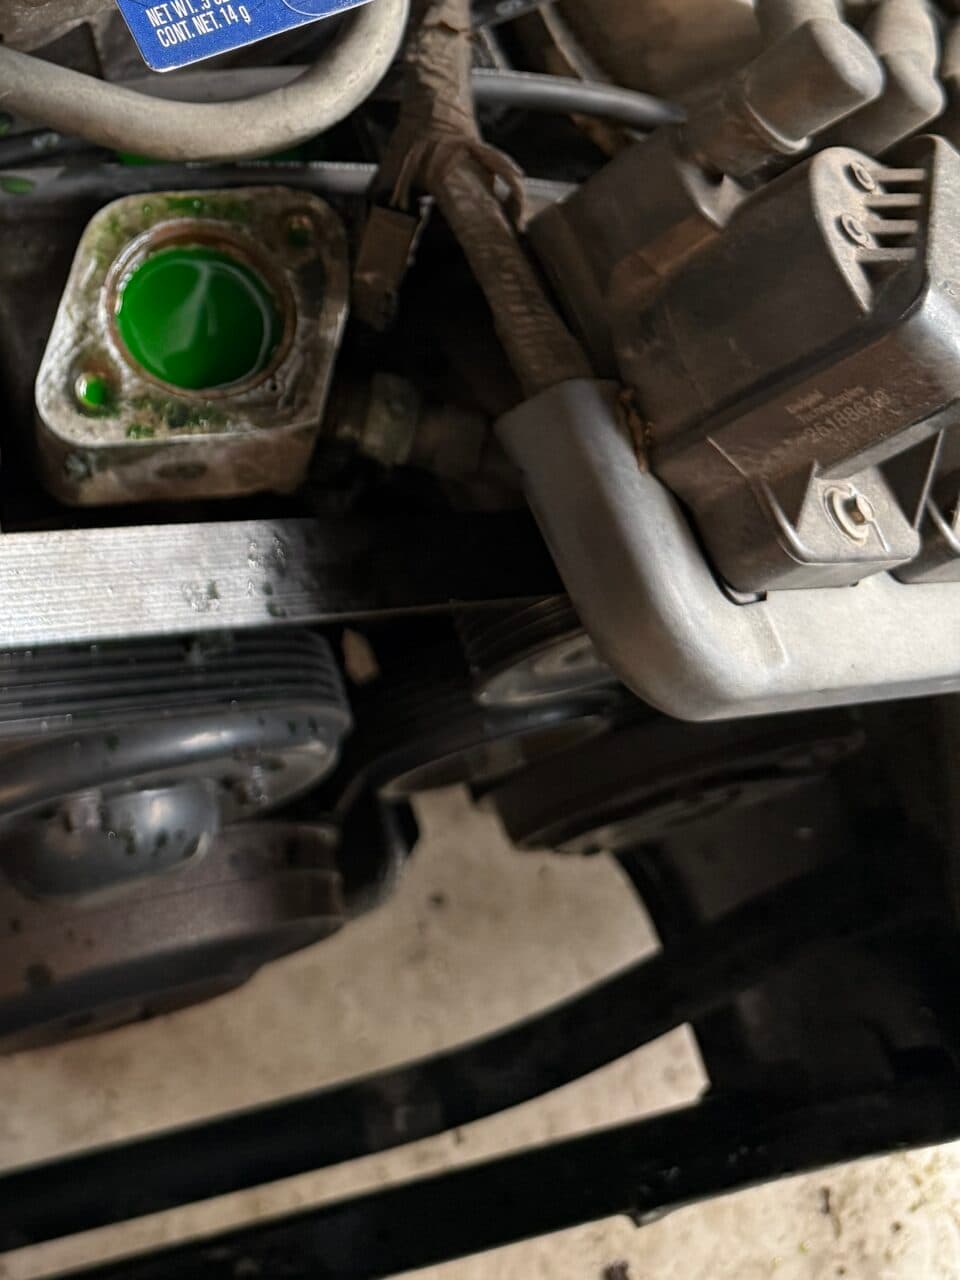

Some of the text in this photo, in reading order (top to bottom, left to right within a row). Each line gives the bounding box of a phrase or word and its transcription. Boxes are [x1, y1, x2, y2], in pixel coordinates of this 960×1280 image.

[145, 4, 173, 27] NET
[156, 5, 251, 48] CONT. NET. 14 g
